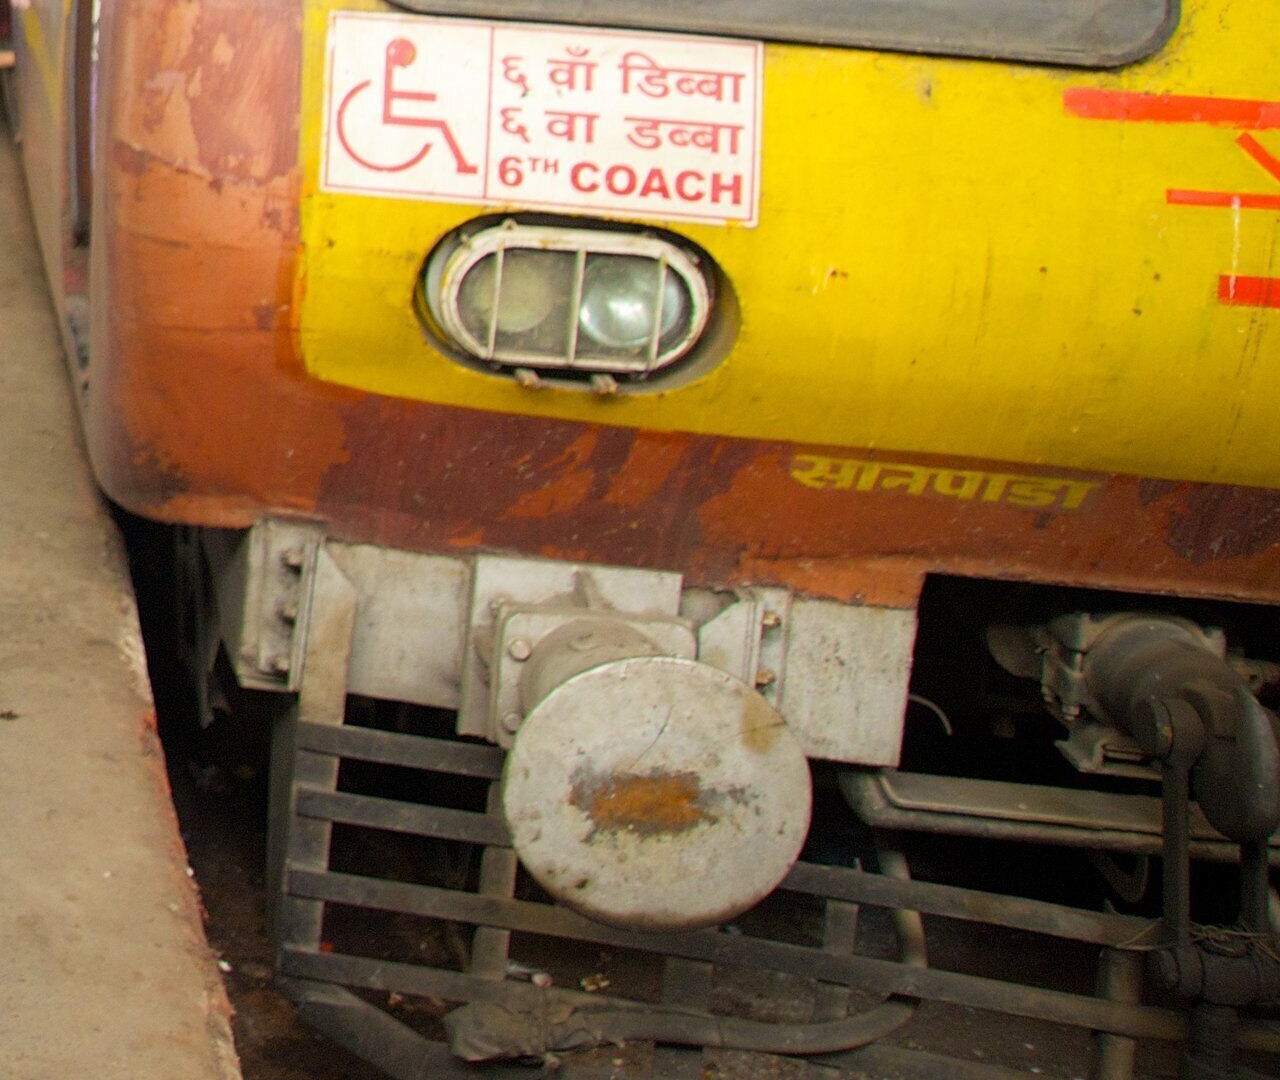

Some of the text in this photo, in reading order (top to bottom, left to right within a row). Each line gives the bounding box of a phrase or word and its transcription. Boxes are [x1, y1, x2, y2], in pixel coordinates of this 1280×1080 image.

[618, 51, 745, 103] डिब्बा
[544, 110, 599, 143] वा
[624, 116, 744, 155] डब्बा
[498, 156, 742, 205] 6TH COACH
